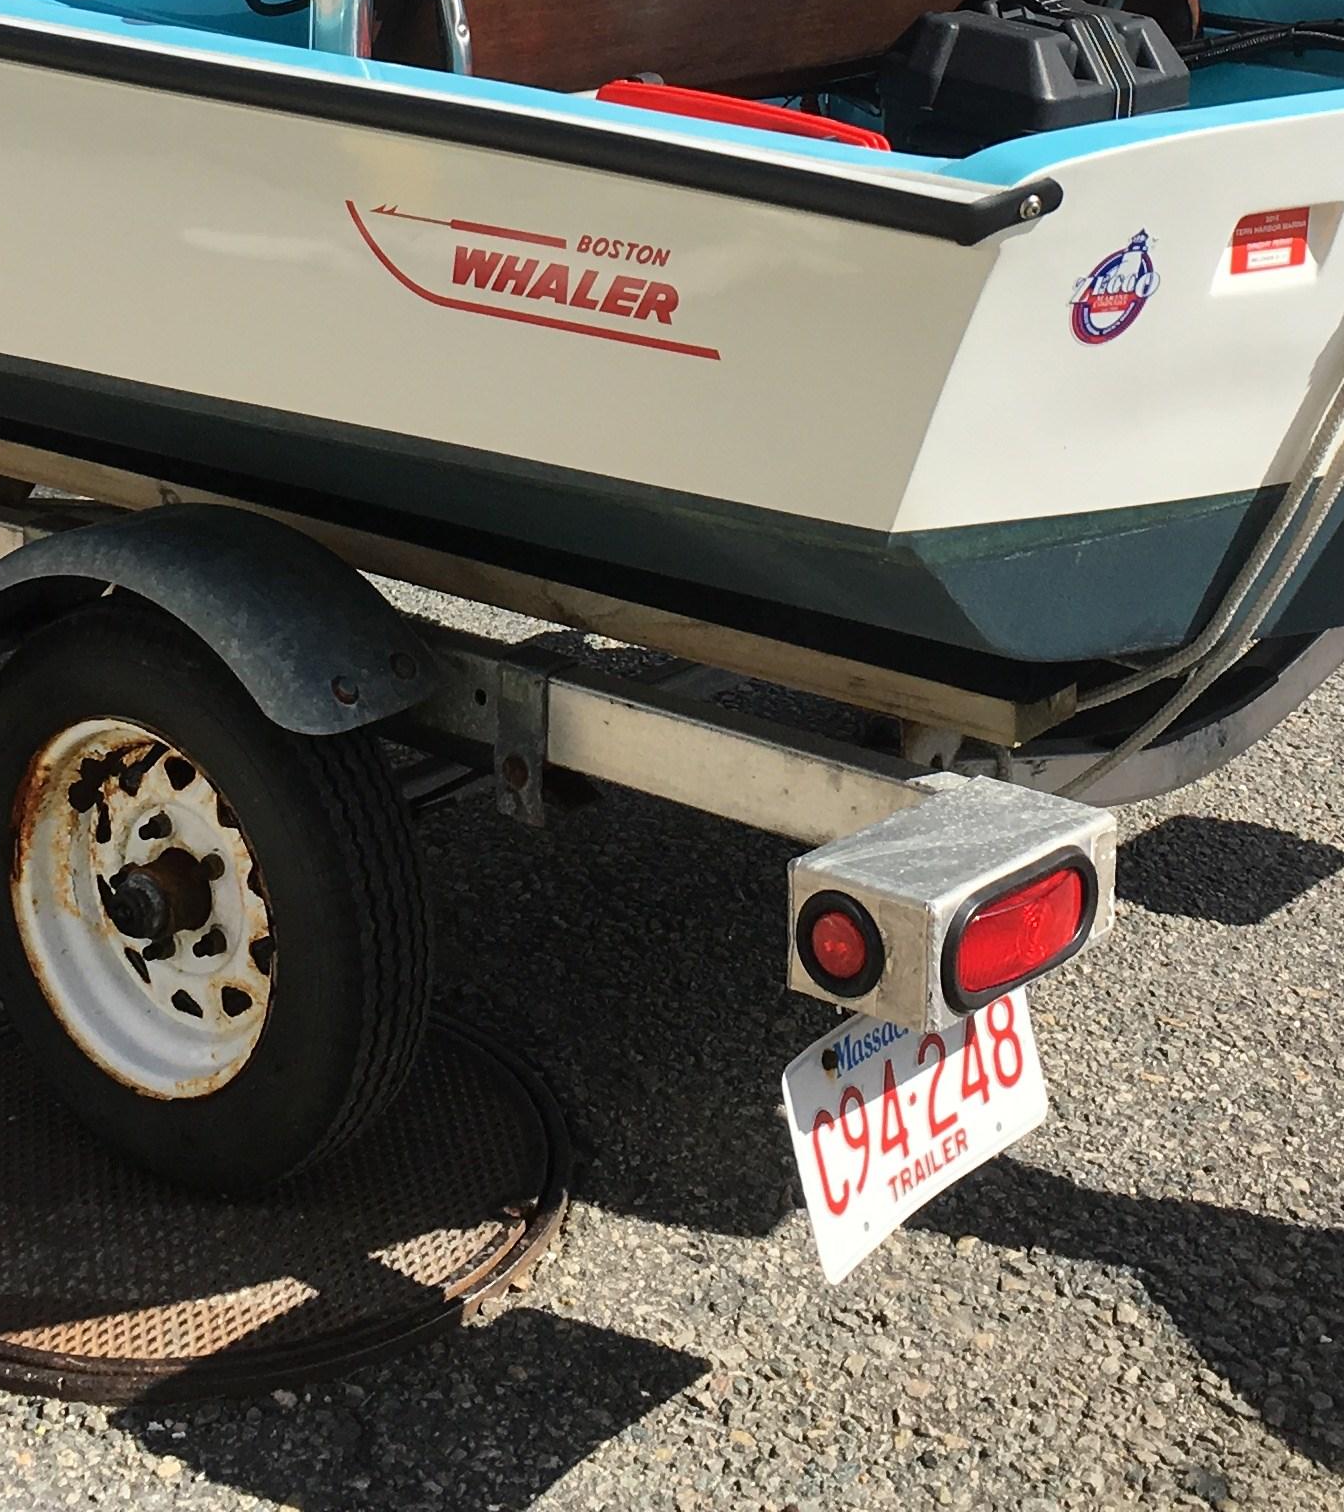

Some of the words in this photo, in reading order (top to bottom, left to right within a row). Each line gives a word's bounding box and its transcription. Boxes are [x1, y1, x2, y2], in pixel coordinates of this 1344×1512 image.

[576, 234, 672, 268] BOSTON
[1254, 223, 1282, 235] HARBOR
[1282, 219, 1307, 231] MARINA
[451, 245, 680, 326] WHALER
[832, 1021, 910, 1079] Massac
[887, 1127, 969, 1203] TRAILER
